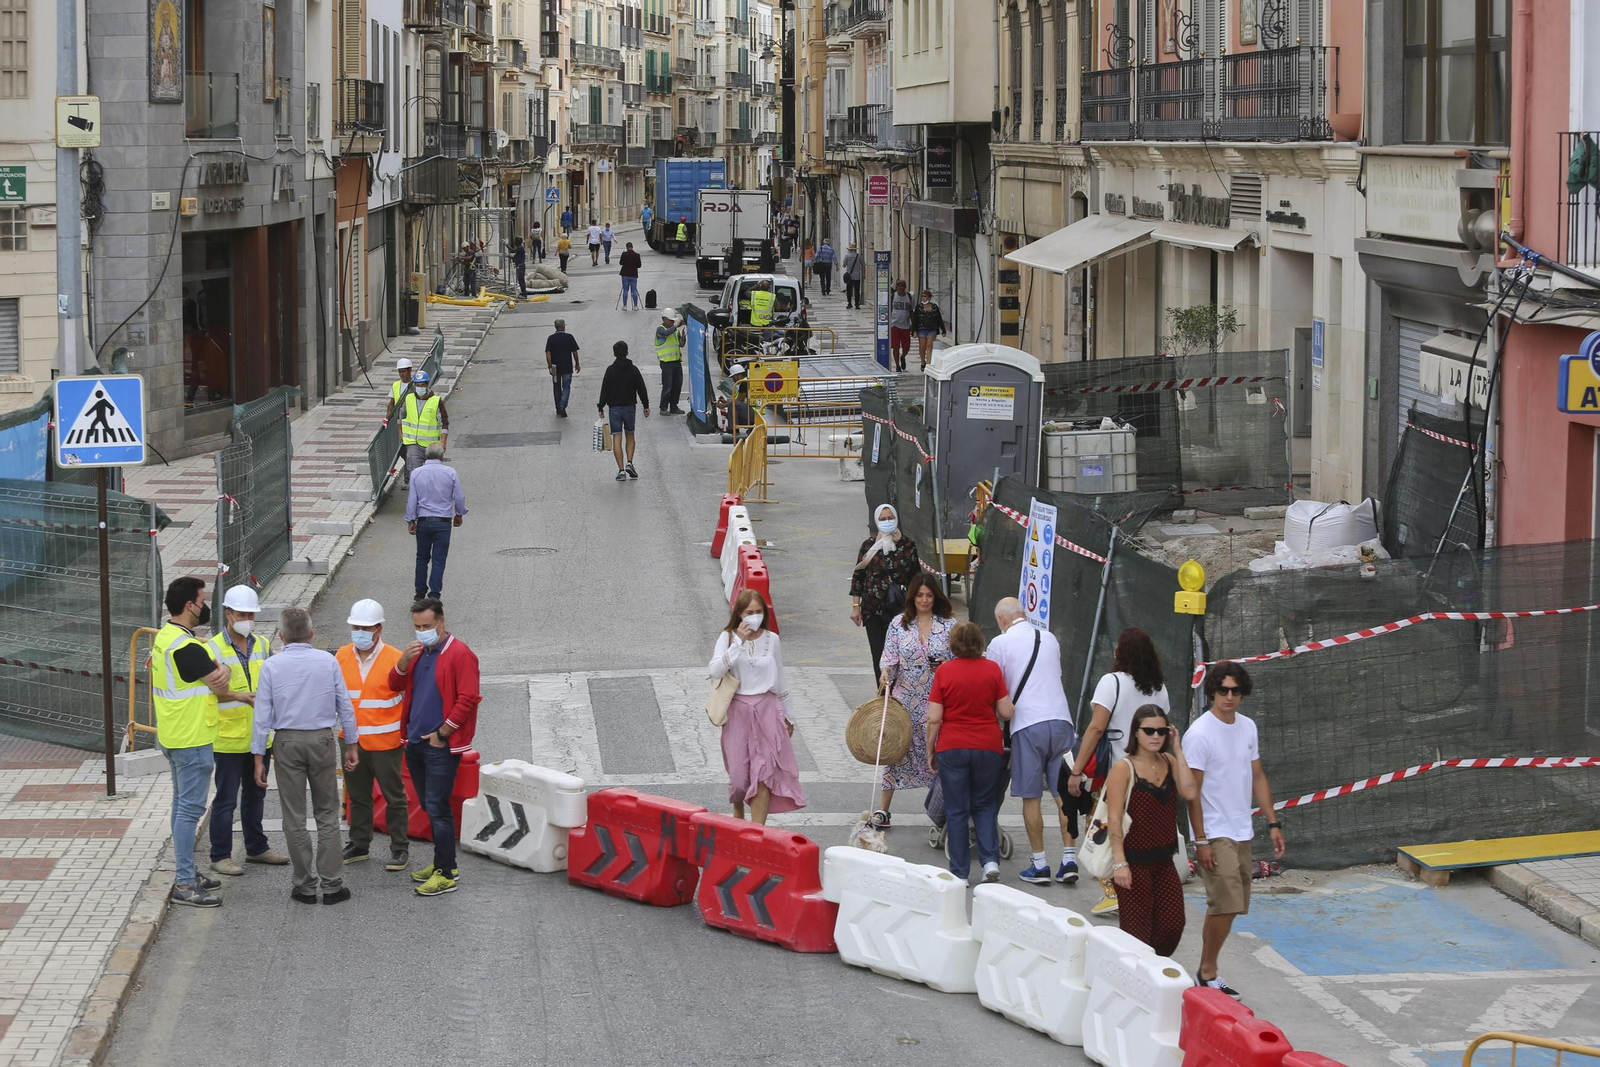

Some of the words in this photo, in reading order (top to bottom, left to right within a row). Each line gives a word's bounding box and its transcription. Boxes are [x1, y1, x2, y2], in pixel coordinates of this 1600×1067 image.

[703, 202, 743, 213] RDA
[877, 253, 889, 262] BUS
[1449, 367, 1462, 388] LA
[1580, 386, 1600, 408] A
